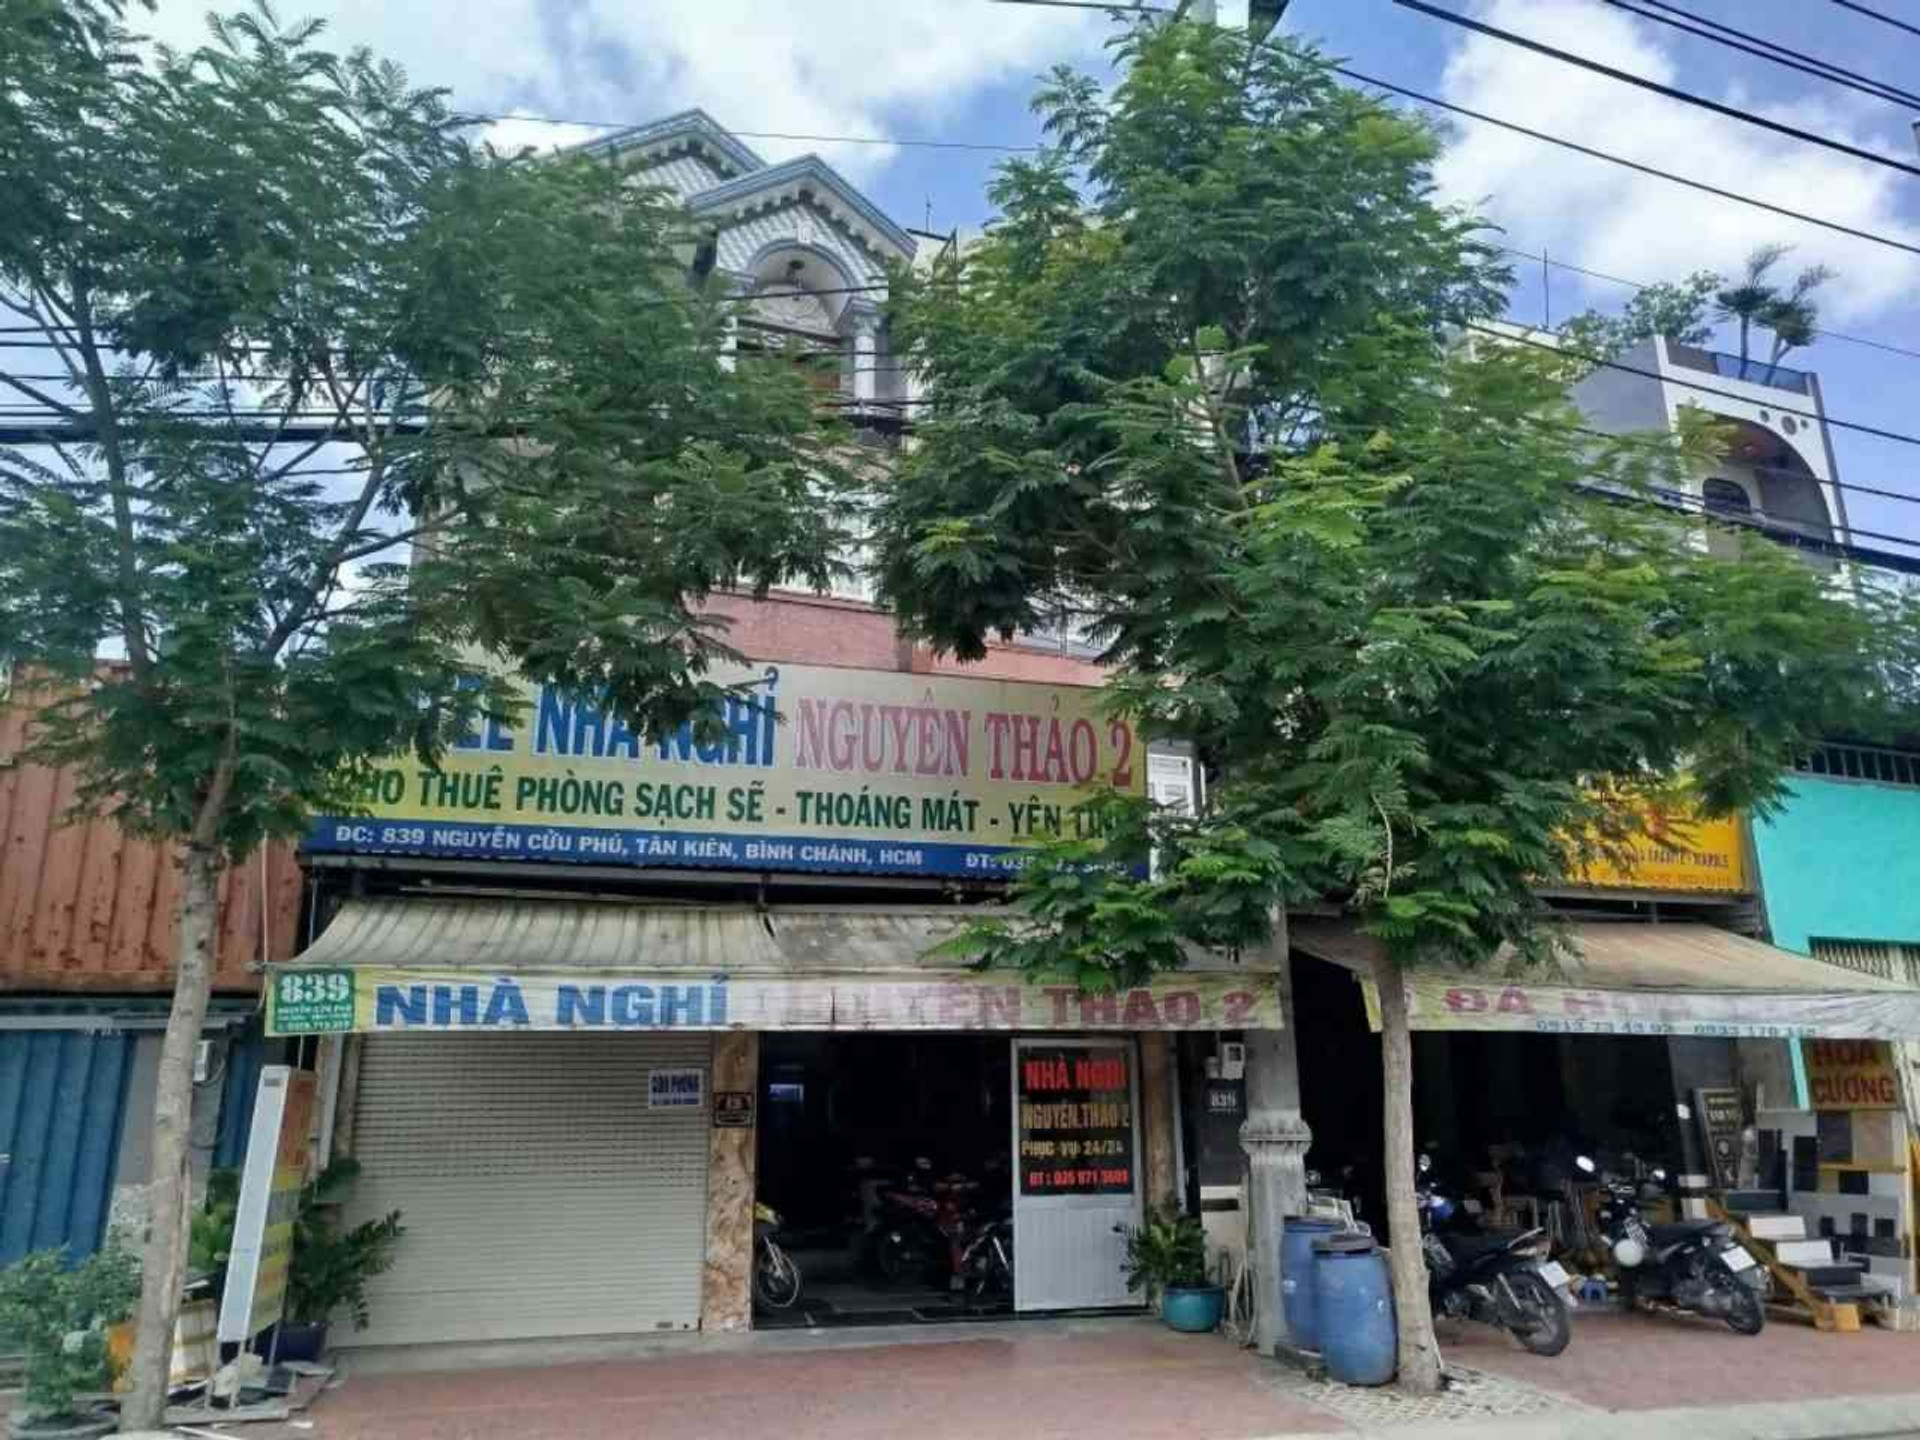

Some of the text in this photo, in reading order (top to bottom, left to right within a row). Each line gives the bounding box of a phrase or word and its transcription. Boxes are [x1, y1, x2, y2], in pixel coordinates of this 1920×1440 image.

[985, 695, 1098, 784] THẢO
[1107, 716, 1133, 787] 2
[418, 765, 503, 809] THUÊ
[516, 769, 624, 816] PHÒNG
[634, 782, 716, 826] SẠCH
[727, 780, 765, 822] SẼ
[795, 785, 911, 829] THOÁNG
[921, 790, 980, 832] MÁT
[382, 828, 425, 845] 839
[745, 841, 794, 860] BÌNH
[801, 844, 873, 866] CHÁNH,
[880, 849, 922, 865] HCM
[281, 974, 349, 1003] 839
[376, 977, 529, 1027] NHÀ
[556, 973, 729, 1026] NGHỈ
